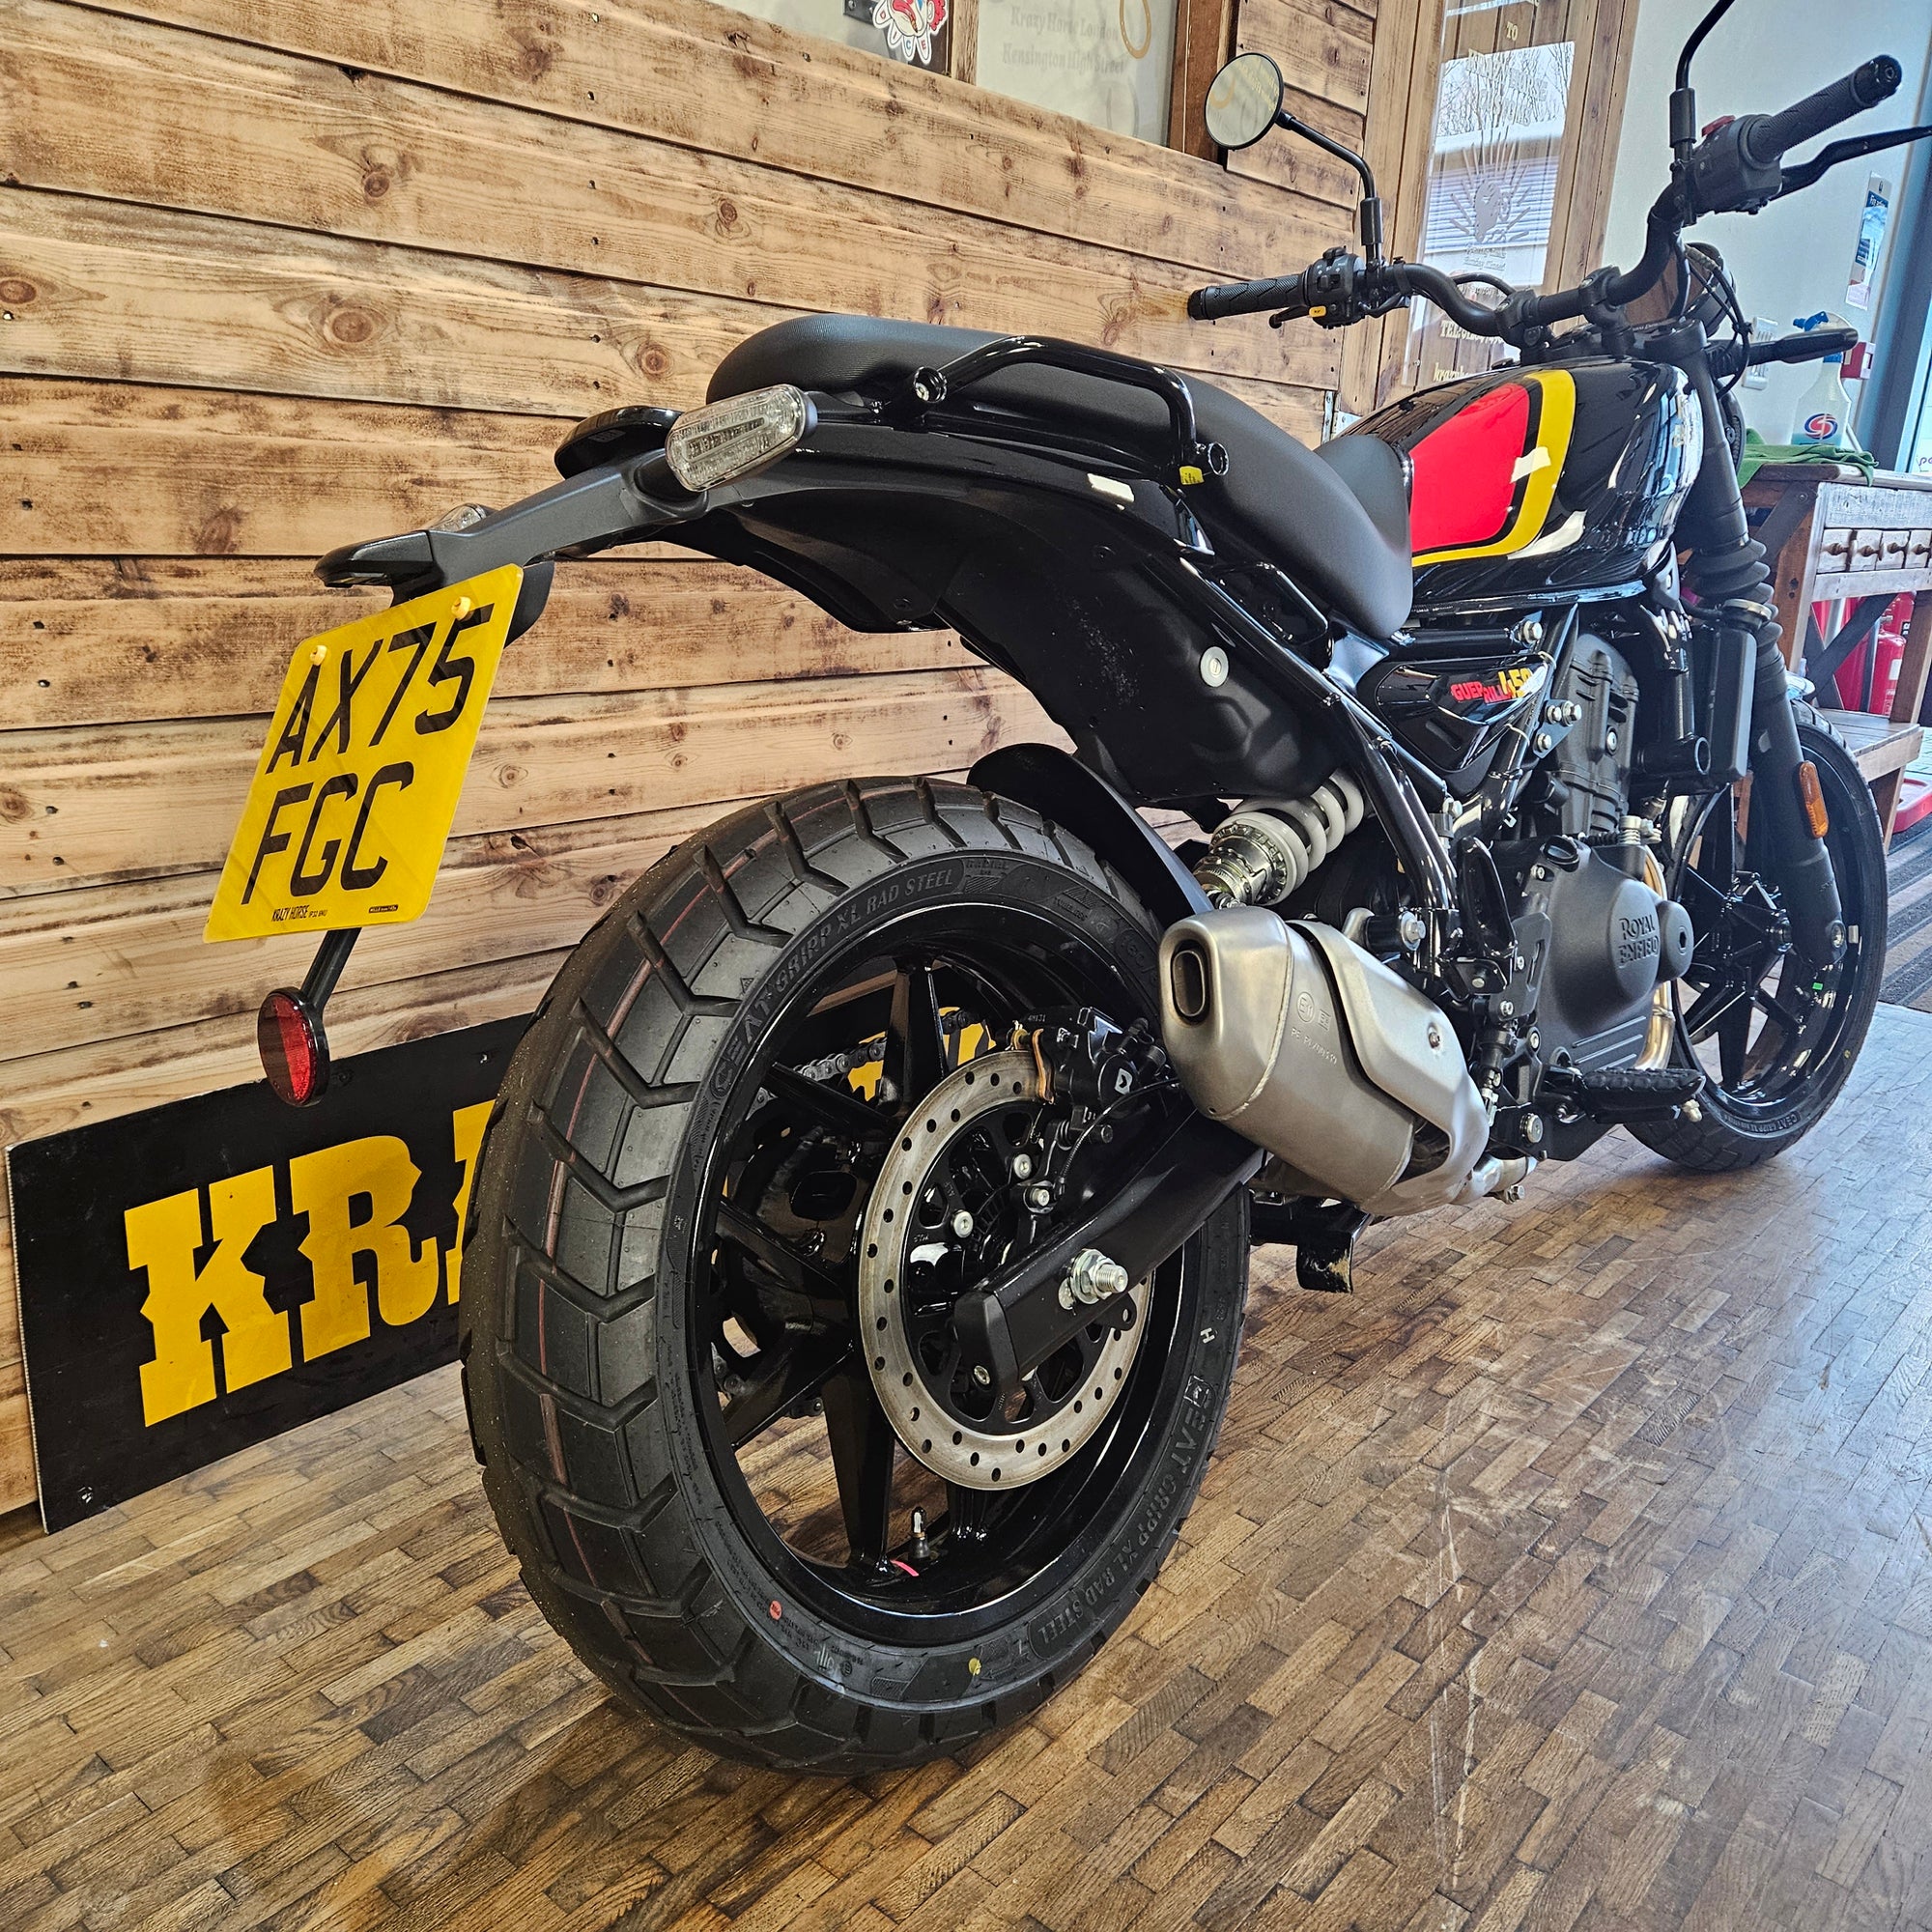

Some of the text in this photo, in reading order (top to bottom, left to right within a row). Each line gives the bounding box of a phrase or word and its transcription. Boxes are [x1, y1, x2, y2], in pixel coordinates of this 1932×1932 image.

[1010, 5, 1044, 36] Krazy
[1080, 17, 1120, 43] London
[1506, 20, 1520, 42] TO
[1002, 42, 1066, 72] Kensington
[265, 603, 495, 775] AX75
[241, 760, 415, 905] FGC
[1618, 914, 1656, 940] ROYAL
[1617, 934, 1660, 968] ENFIELD
[713, 978, 778, 1094] CEAT
[835, 899, 863, 936] XL
[865, 883, 900, 917] RAD
[902, 867, 953, 898] STEEL
[1037, 1597, 1085, 1644] STEEL
